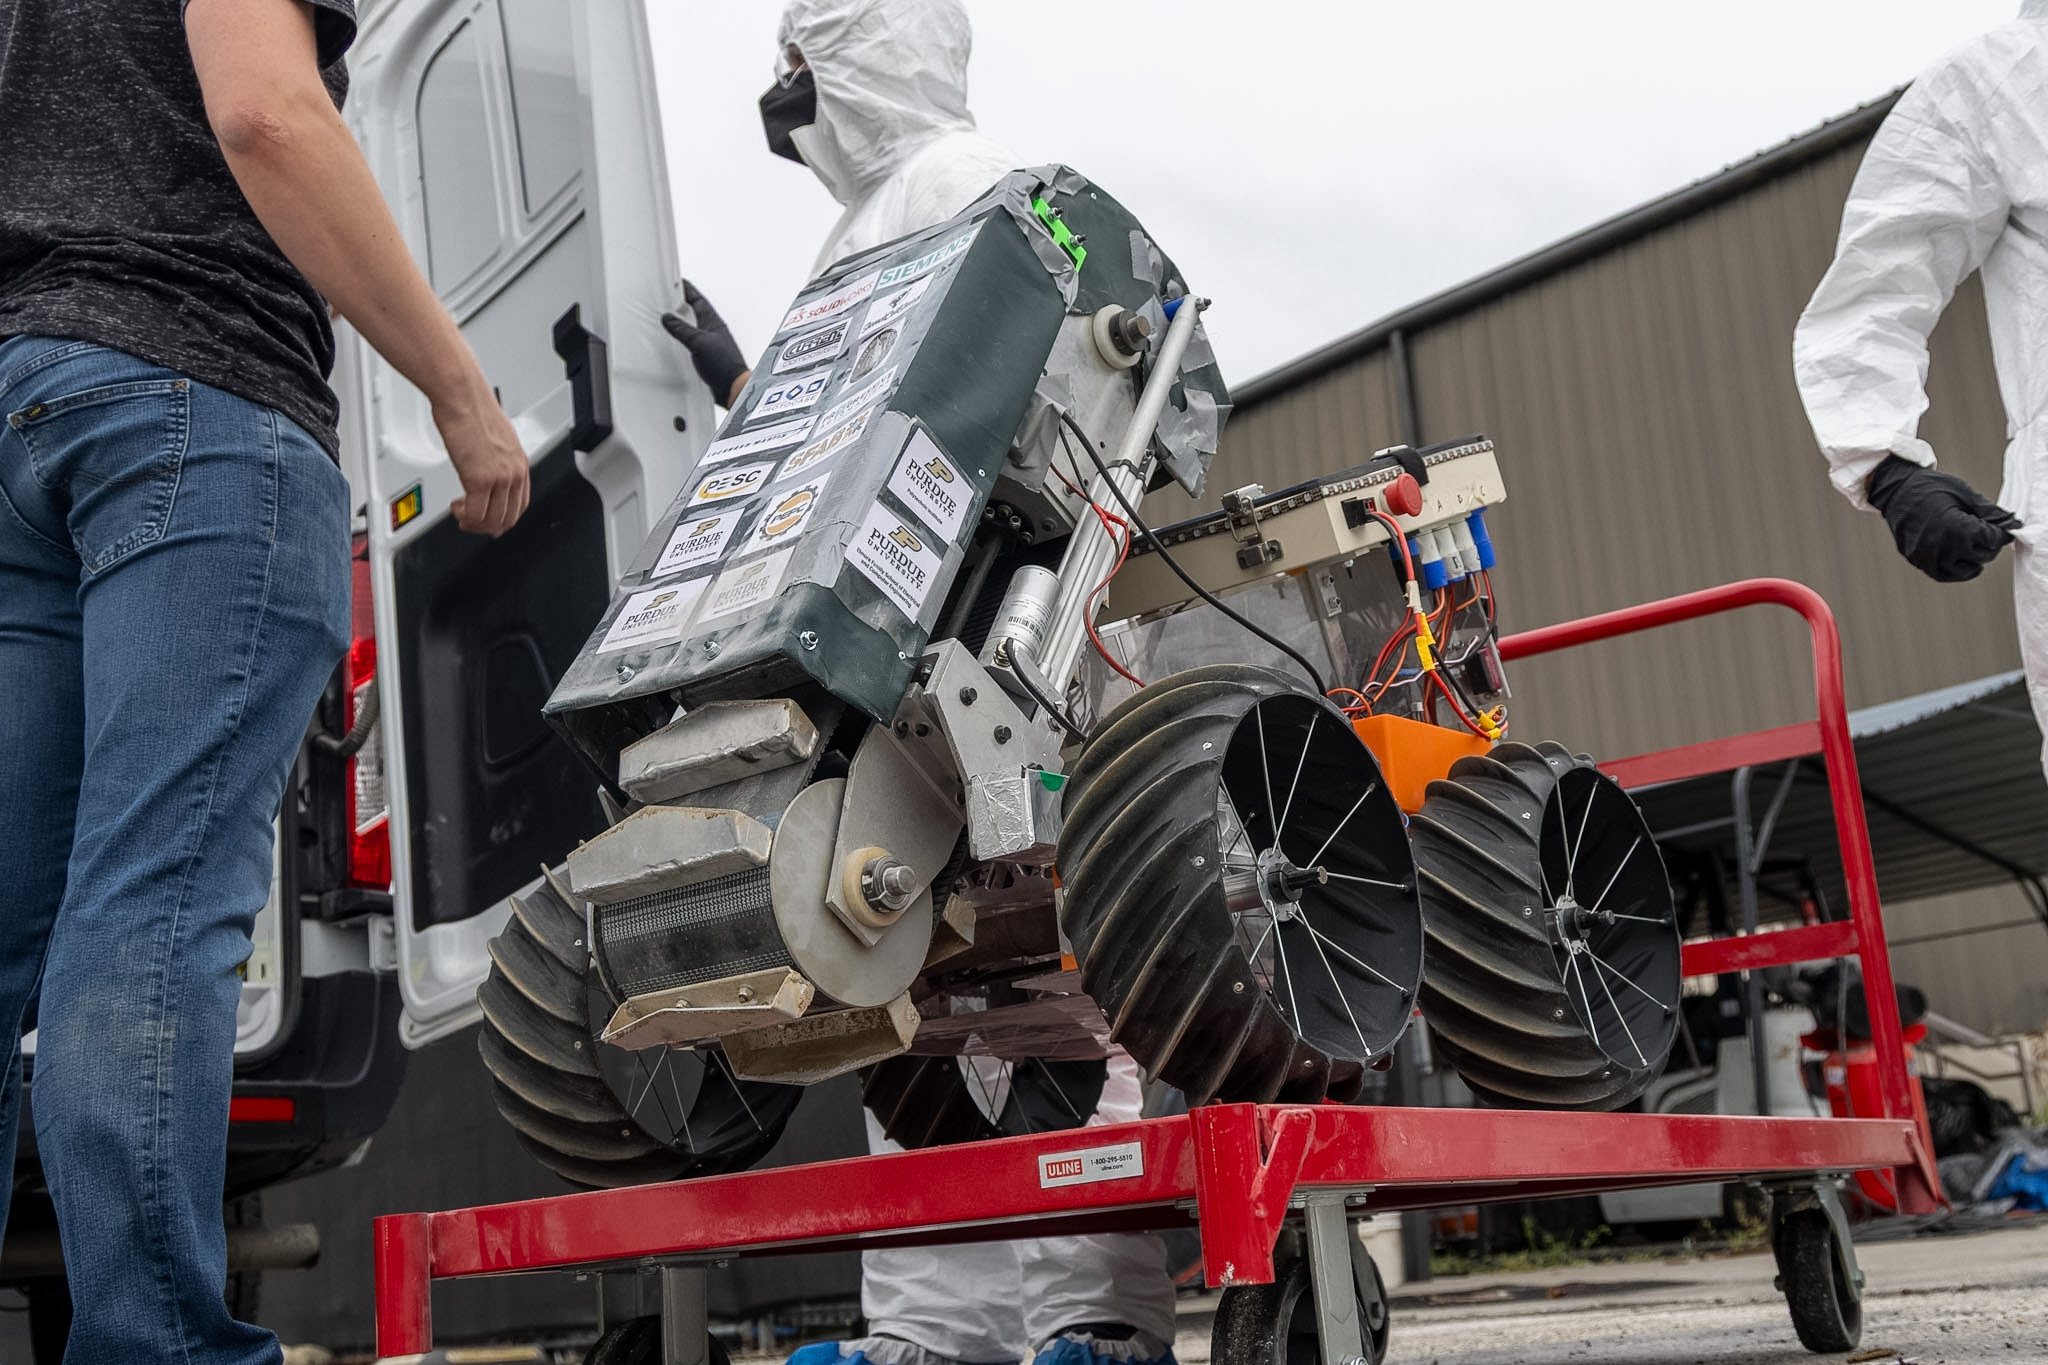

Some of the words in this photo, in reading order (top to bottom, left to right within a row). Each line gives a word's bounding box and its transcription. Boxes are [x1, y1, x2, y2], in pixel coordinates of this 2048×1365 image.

[880, 235, 972, 285] SIEMENS
[907, 459, 957, 513] PURDUE
[671, 530, 724, 552] PURDUE
[869, 526, 926, 584] PURDUE
[715, 574, 771, 602] PURDUE
[856, 546, 871, 562] Elmore
[870, 559, 885, 575] Family
[884, 572, 898, 587] School
[901, 588, 920, 608] Electrical
[860, 558, 869, 568] and
[868, 565, 888, 587] Computer
[887, 583, 912, 609] Engineering
[623, 603, 680, 625] PURDUE
[1047, 1161, 1081, 1177] ULINE
